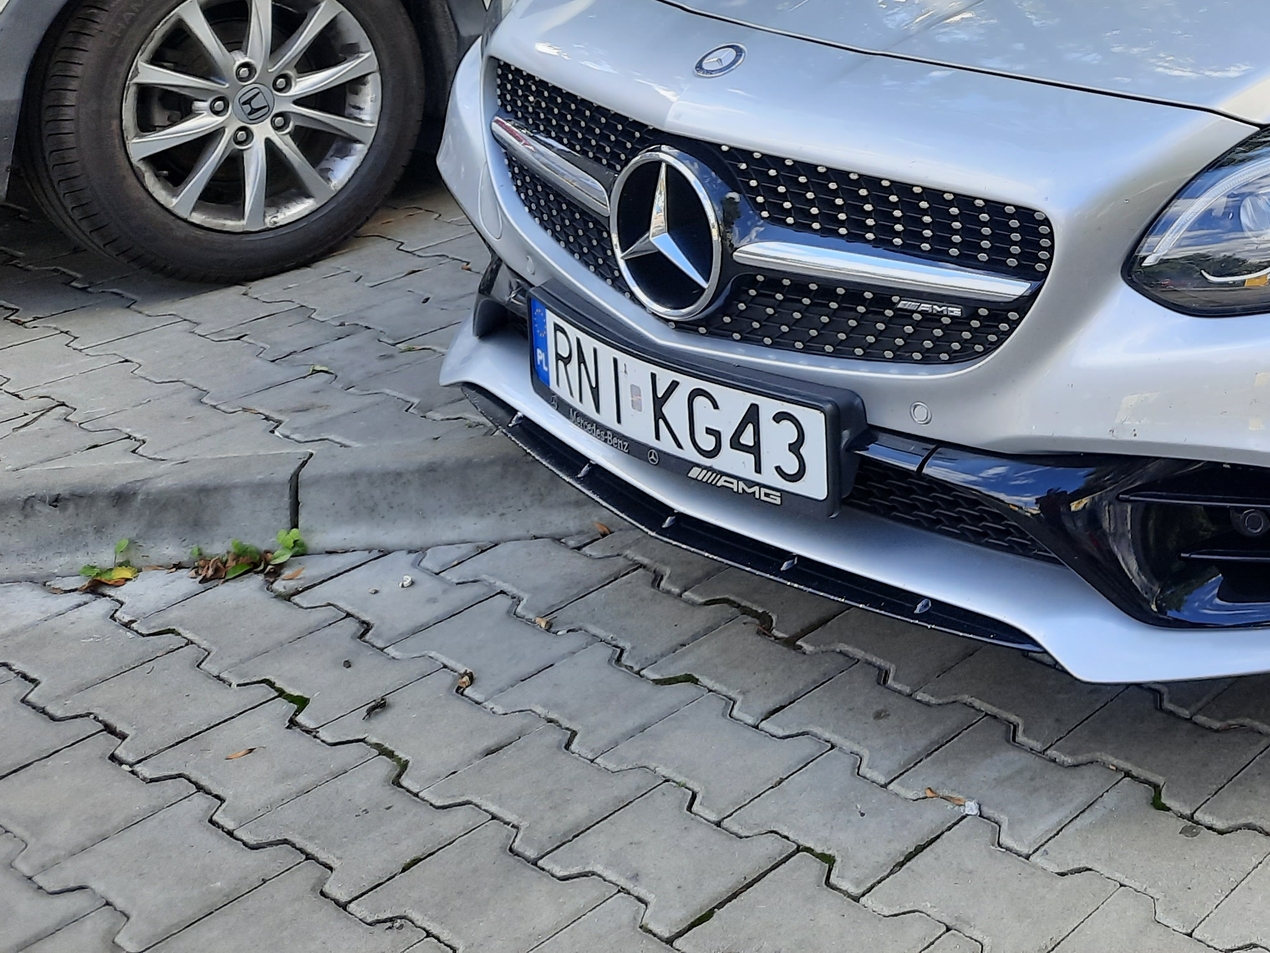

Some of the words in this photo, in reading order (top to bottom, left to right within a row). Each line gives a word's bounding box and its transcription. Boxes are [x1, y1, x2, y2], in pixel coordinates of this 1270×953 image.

[917, 302, 962, 317] AMG
[537, 348, 549, 372] PL
[553, 321, 622, 425] RNI
[650, 372, 807, 483] KG43
[569, 408, 630, 454] Mercedes-Benz
[715, 475, 783, 506] AMG
